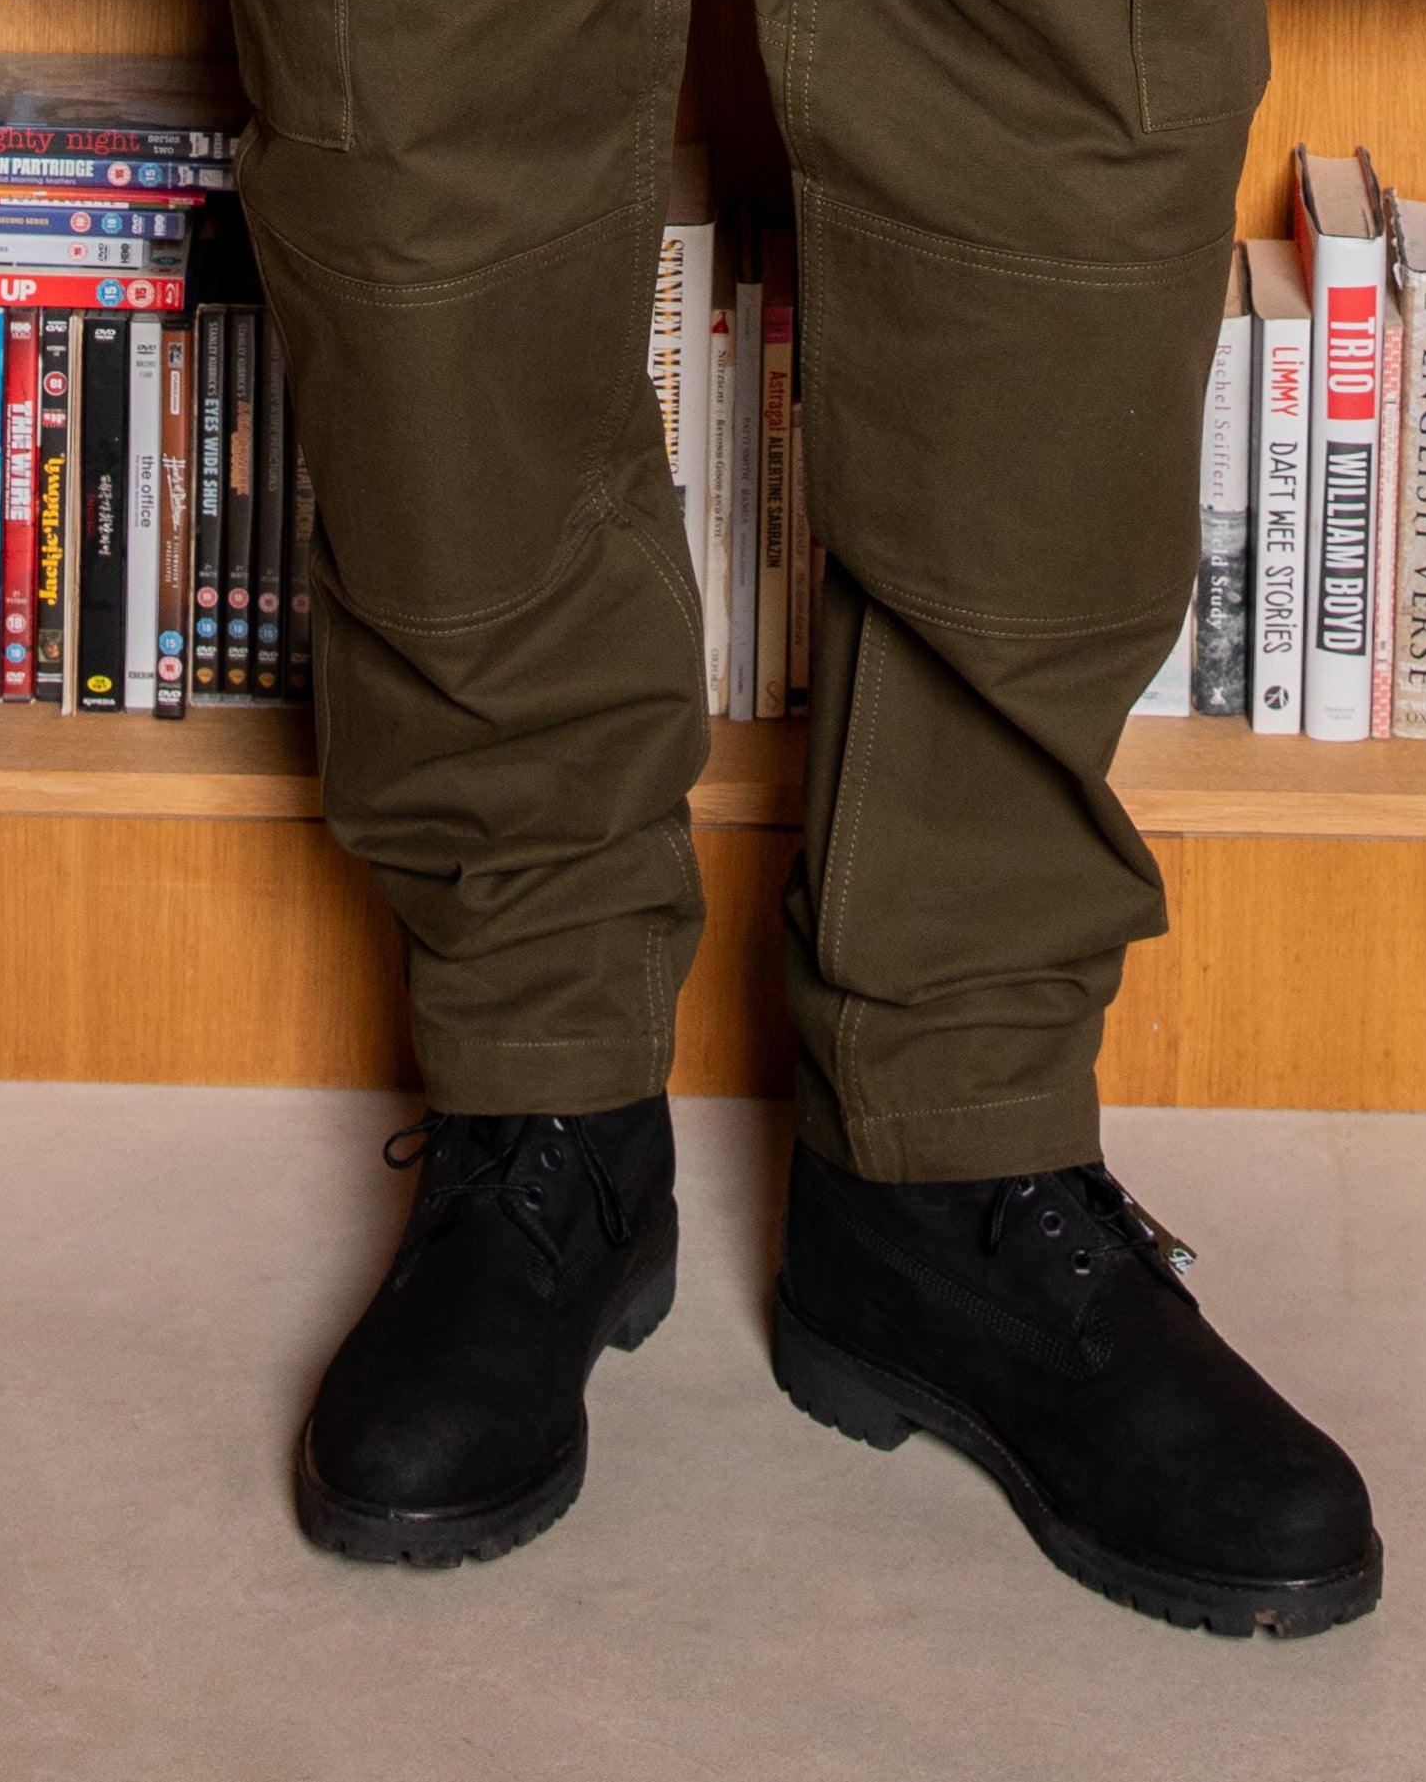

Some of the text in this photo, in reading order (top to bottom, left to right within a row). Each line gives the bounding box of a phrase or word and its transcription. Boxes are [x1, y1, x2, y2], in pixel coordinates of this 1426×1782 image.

[67, 129, 140, 158] night
[141, 455, 154, 528] the office
[1268, 441, 1297, 499] DAFT
[1323, 317, 1374, 649] TRIO WILLIAM BOYD
[1267, 511, 1293, 552] WEE
[1264, 565, 1296, 653] STORIES
